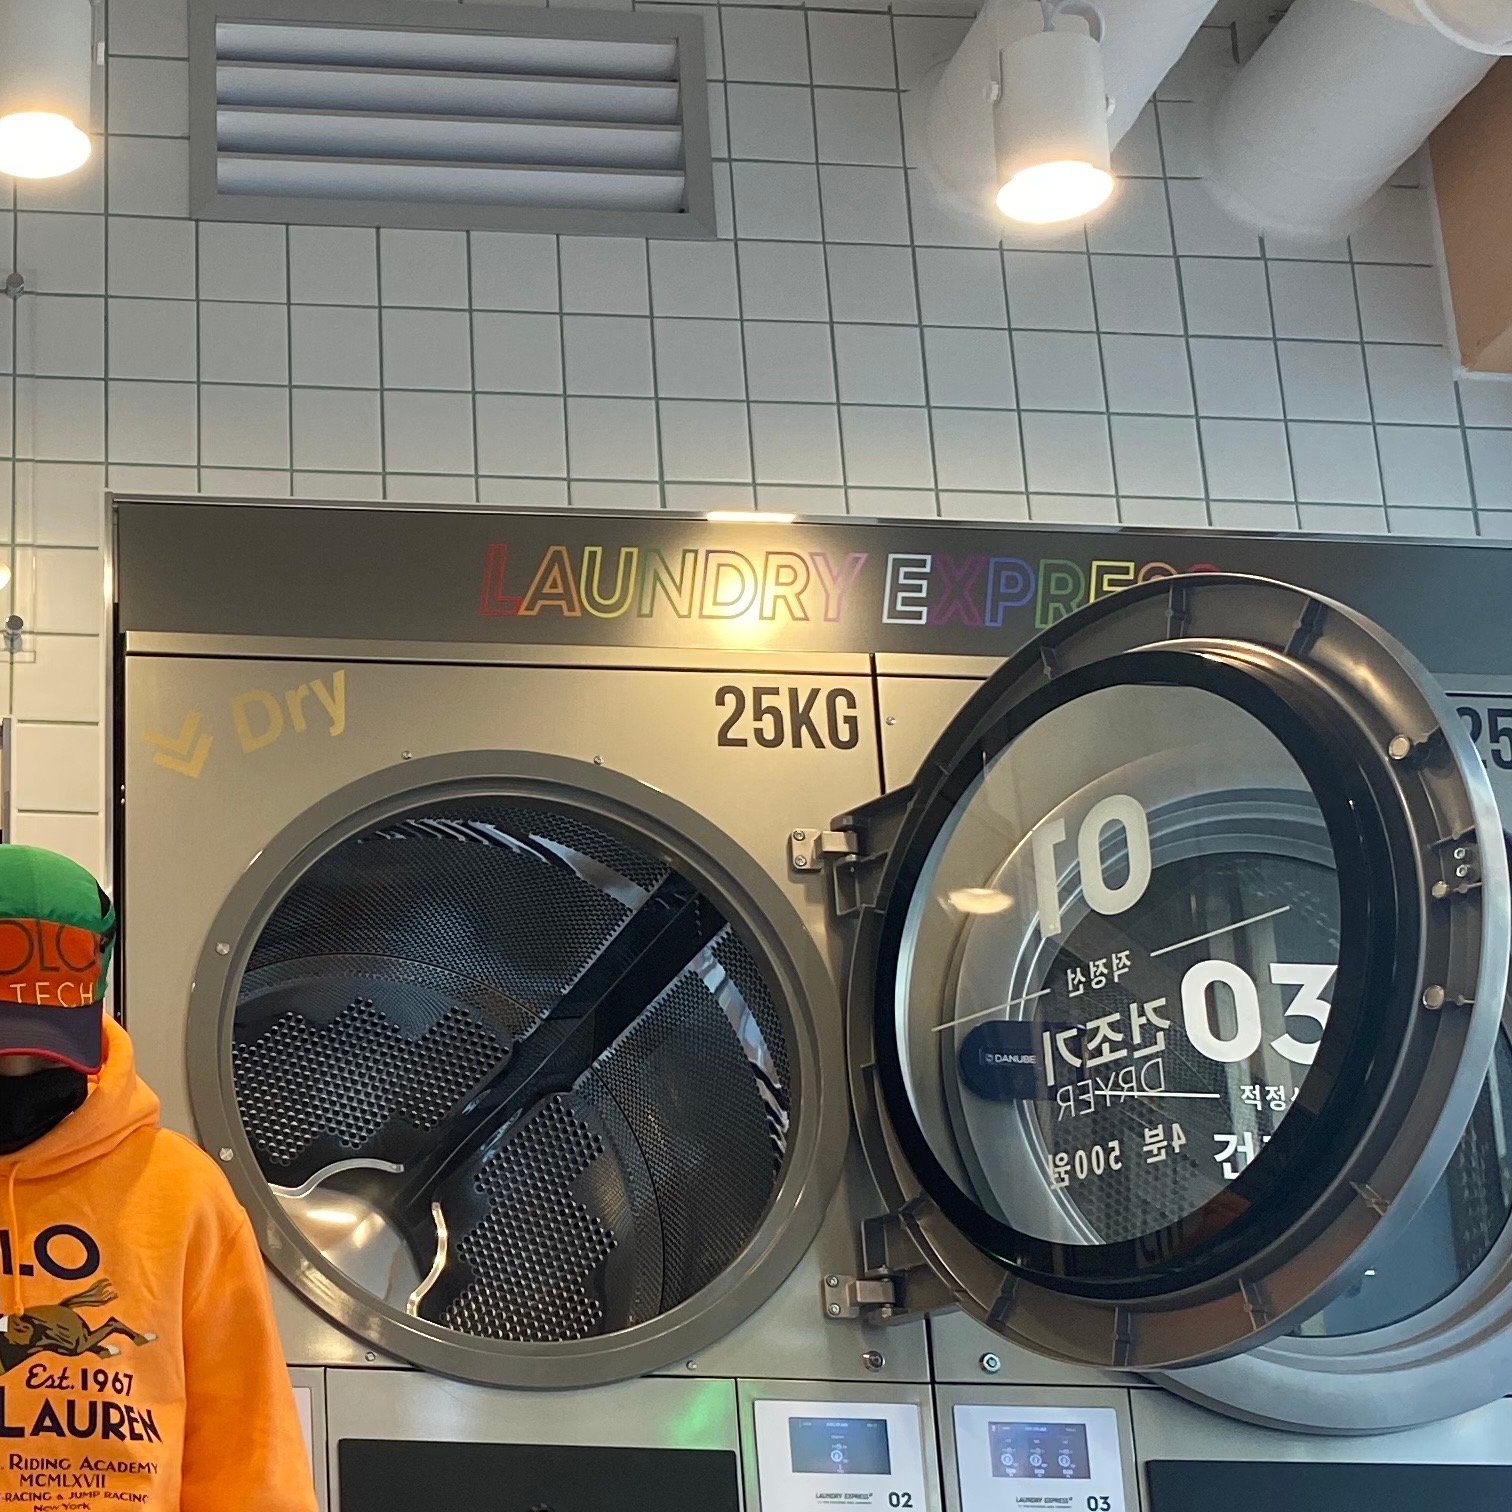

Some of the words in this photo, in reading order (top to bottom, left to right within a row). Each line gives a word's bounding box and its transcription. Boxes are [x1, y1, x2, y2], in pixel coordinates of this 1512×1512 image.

[480, 544, 868, 623] LAUNDRY
[231, 669, 348, 755] Dry
[714, 685, 860, 750] 25KG
[1180, 959, 1338, 1065] 03
[995, 1054, 1036, 1064] DANUBE
[1239, 1085, 1299, 1112] 적정
[26, 1364, 74, 1391] Est.
[81, 1368, 134, 1396] 1967
[20, 1473, 106, 1488] MCMLXVII
[69, 1491, 100, 1500] JUMP
[888, 1492, 913, 1508] 02
[1087, 1496, 1111, 1512] 03
